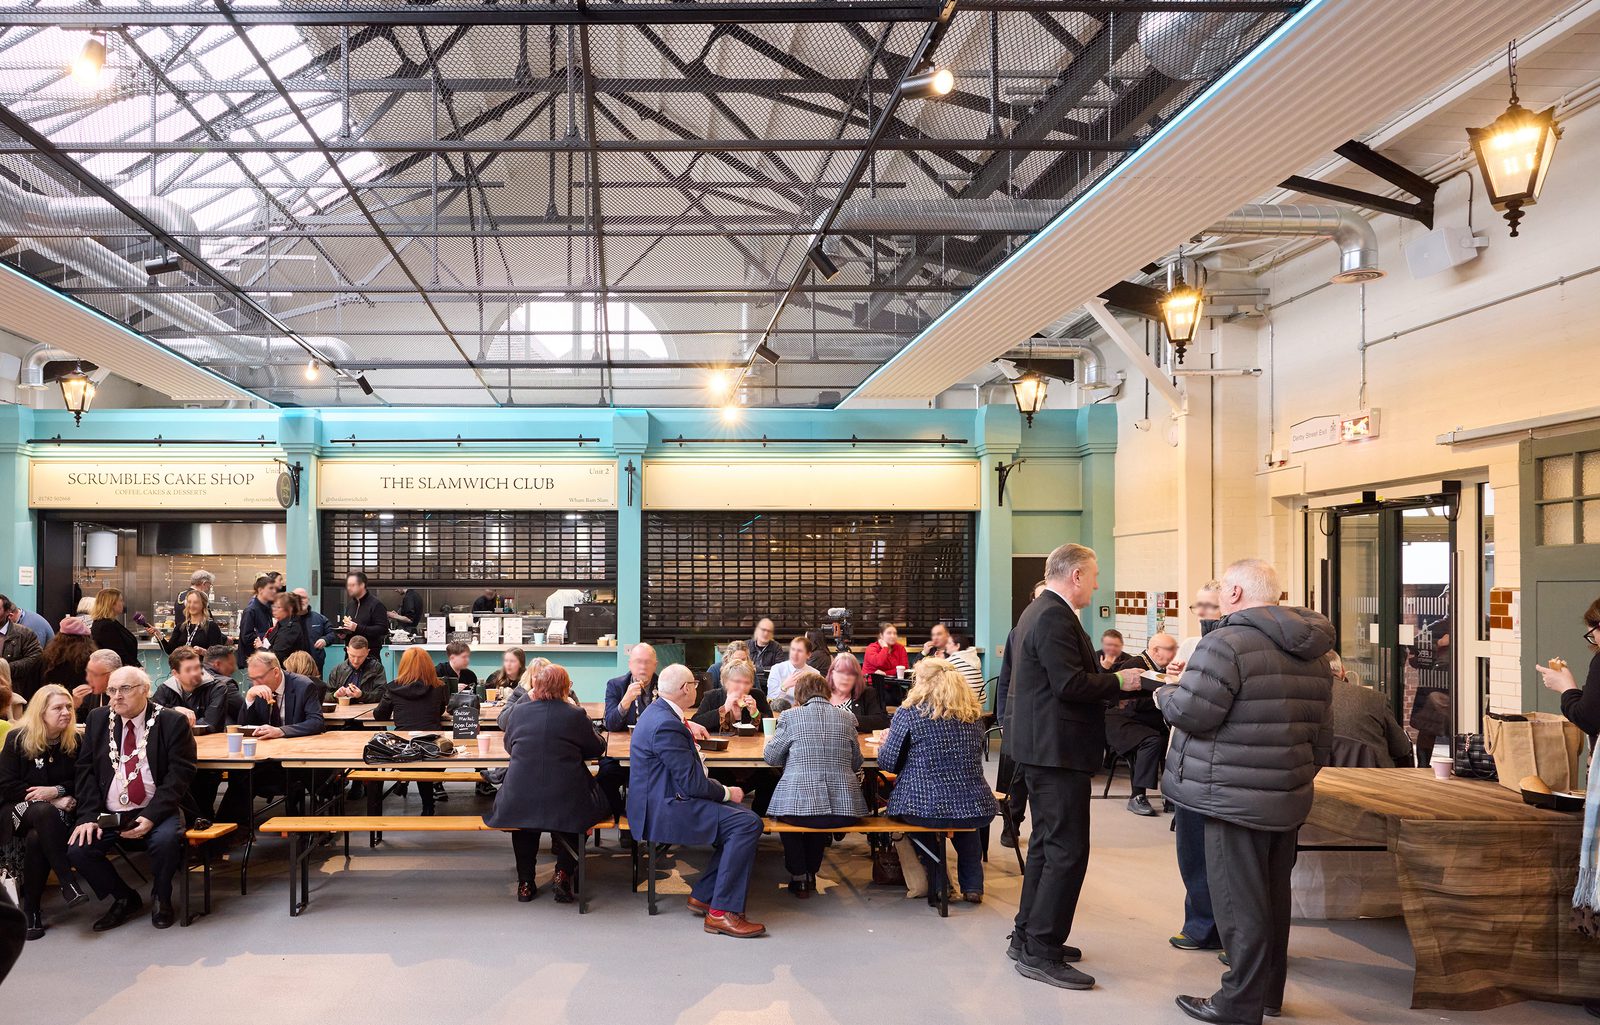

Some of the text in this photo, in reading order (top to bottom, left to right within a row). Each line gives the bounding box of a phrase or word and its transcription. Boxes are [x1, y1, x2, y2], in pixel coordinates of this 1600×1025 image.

[67, 472, 255, 485] SCRUMBLES CAKE SHOP
[380, 476, 555, 490] THE SLAMWICH CLUB
